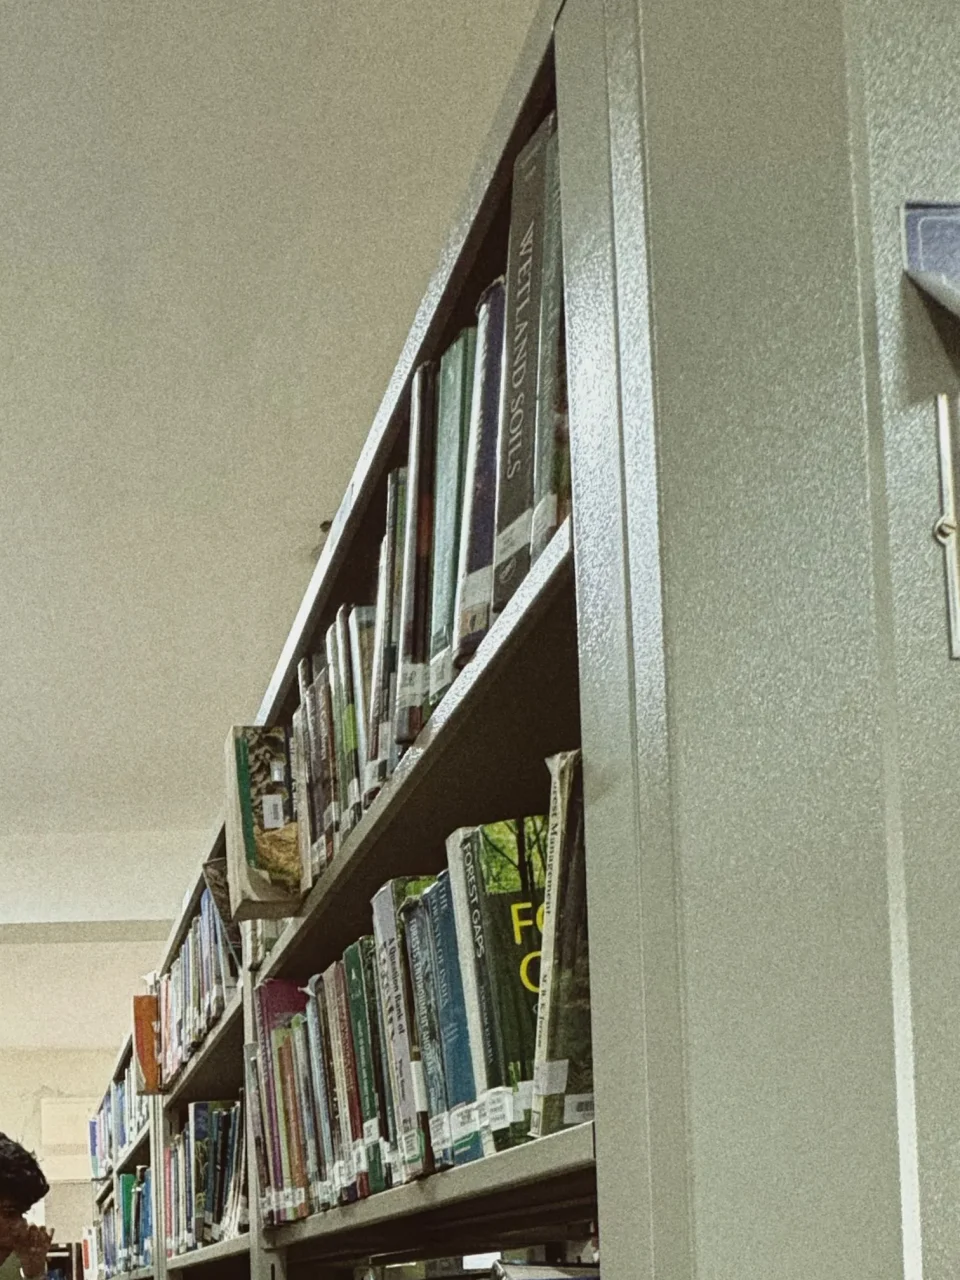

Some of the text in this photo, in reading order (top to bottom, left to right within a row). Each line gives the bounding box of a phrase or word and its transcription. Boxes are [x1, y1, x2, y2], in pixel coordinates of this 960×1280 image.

[507, 219, 534, 480] WETLAND SOILS
[460, 842, 486, 960] FOREST GAPS
